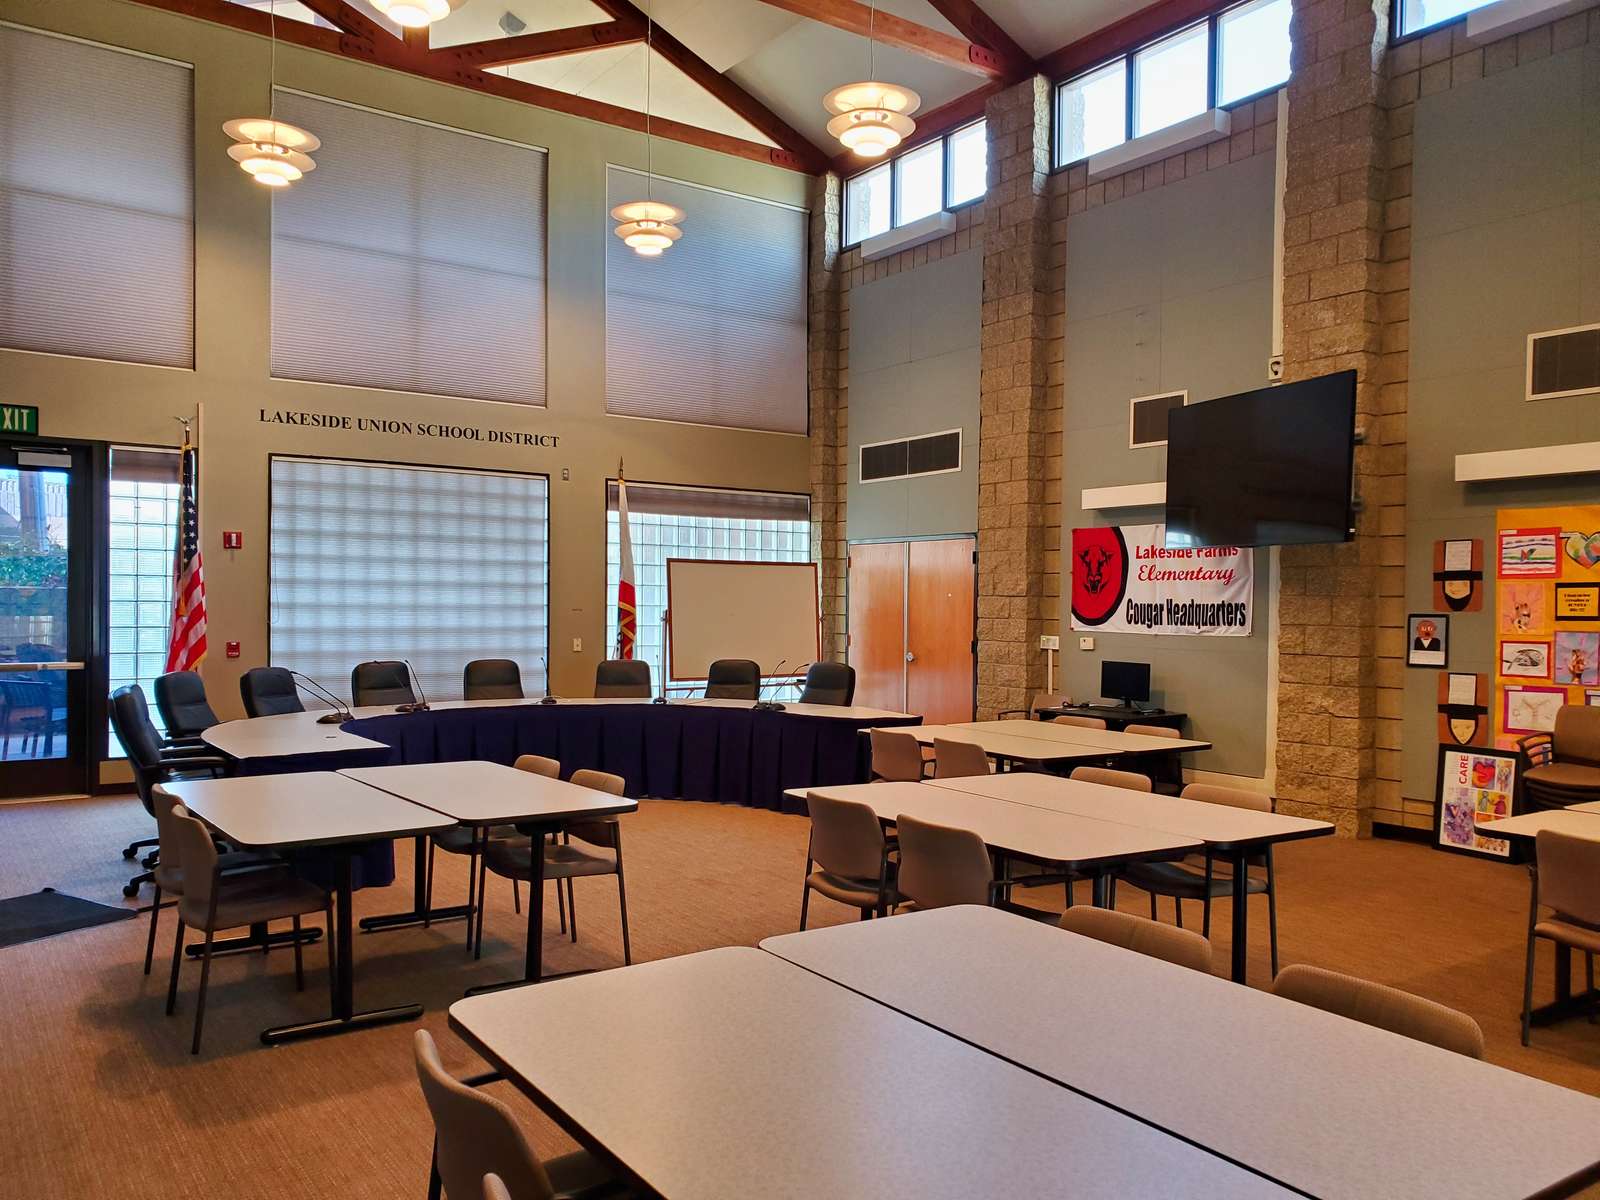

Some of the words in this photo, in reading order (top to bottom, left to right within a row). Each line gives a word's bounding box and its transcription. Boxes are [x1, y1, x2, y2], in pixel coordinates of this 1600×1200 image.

[2, 407, 30, 430] XIT
[259, 408, 352, 430] LAKESIDE
[357, 418, 413, 435] UNION
[417, 423, 485, 441] SCHOOL
[488, 430, 560, 448] DISTRICT
[1137, 564, 1236, 586] Elementary
[1126, 598, 1165, 629] Cougar
[1166, 598, 1247, 630] Headquarters
[1459, 755, 1469, 785] CARE
